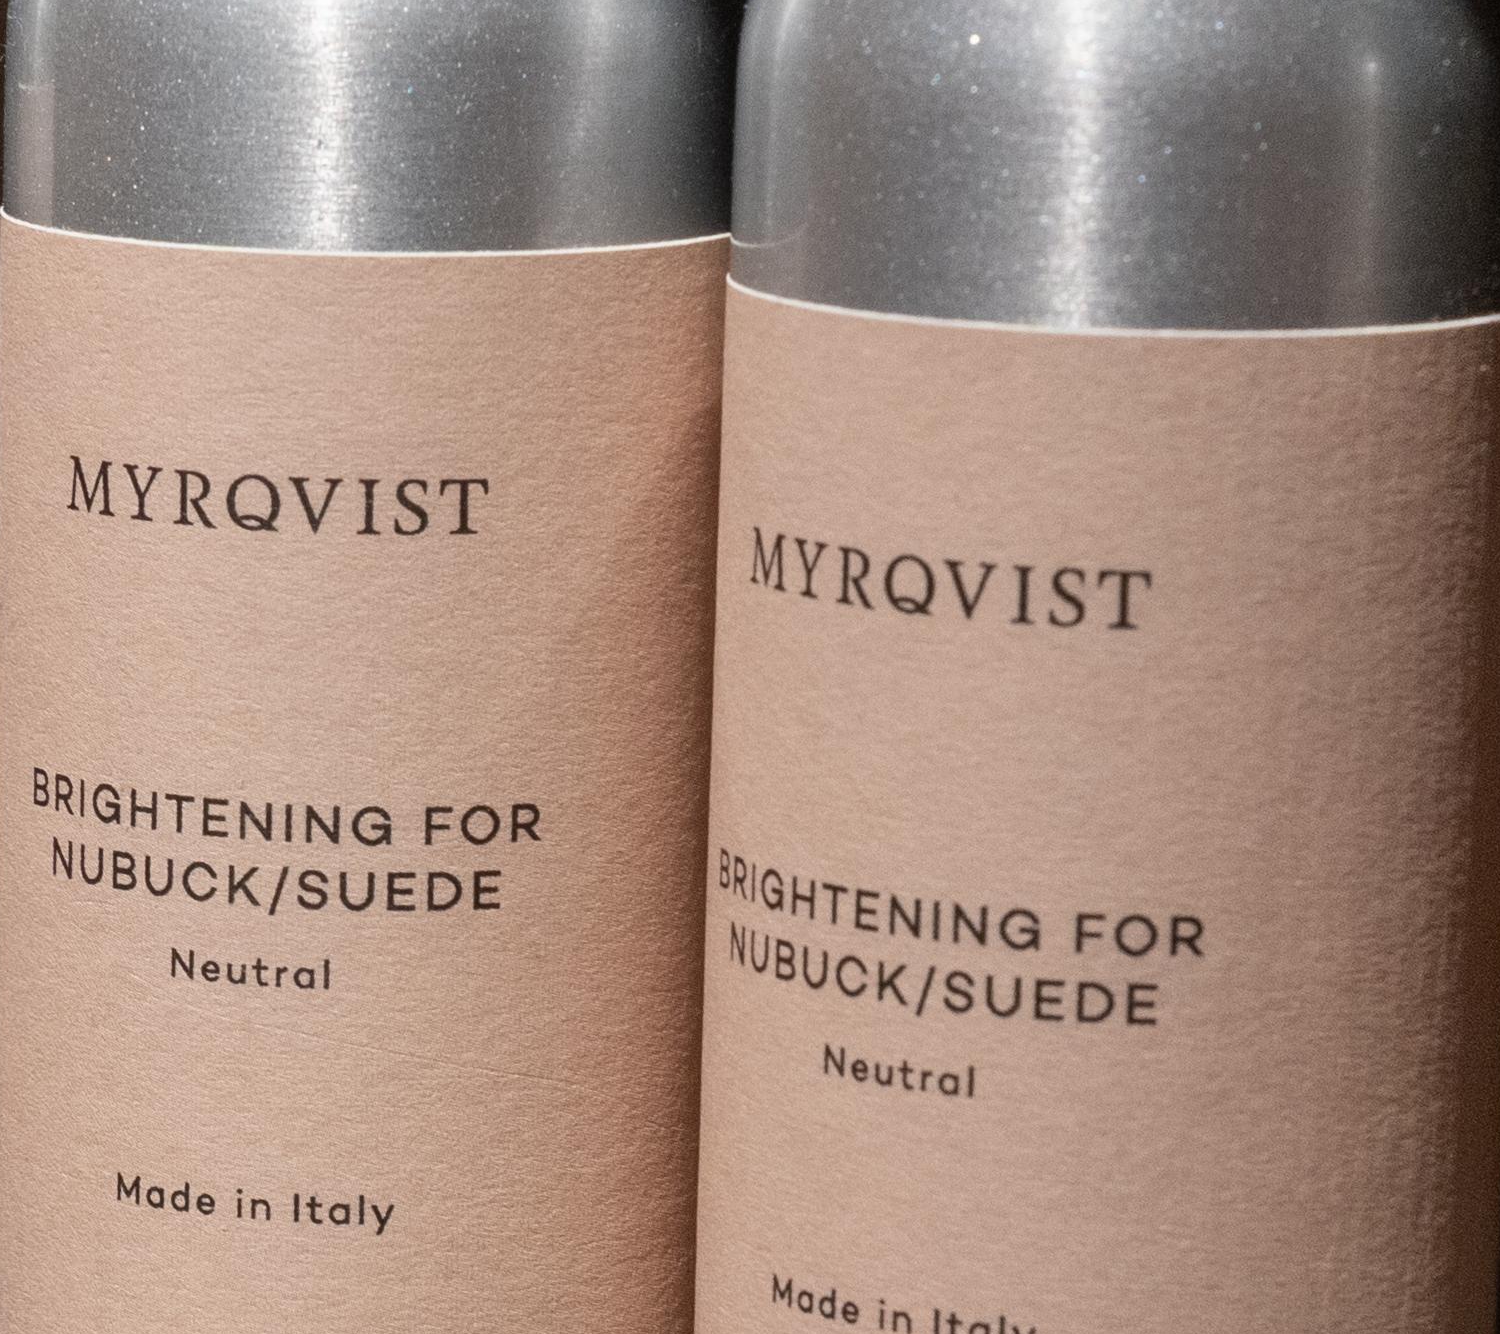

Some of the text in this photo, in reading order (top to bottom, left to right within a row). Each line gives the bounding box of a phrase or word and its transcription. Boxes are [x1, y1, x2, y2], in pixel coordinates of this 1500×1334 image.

[66, 454, 491, 537] MYRQVIST
[749, 525, 1153, 631] MYRQVIST
[32, 766, 542, 847] BRIGHTENING FOR
[51, 835, 501, 917] NUBUCK/SUEDE
[718, 847, 1205, 958] BRIGHTENING FOR
[170, 946, 333, 991] Neutral
[729, 920, 1160, 1027] NUBUCK/SUEDE
[822, 1042, 977, 1098] Neutral
[116, 1170, 396, 1237] Made in Italy
[771, 1272, 861, 1326] Made
